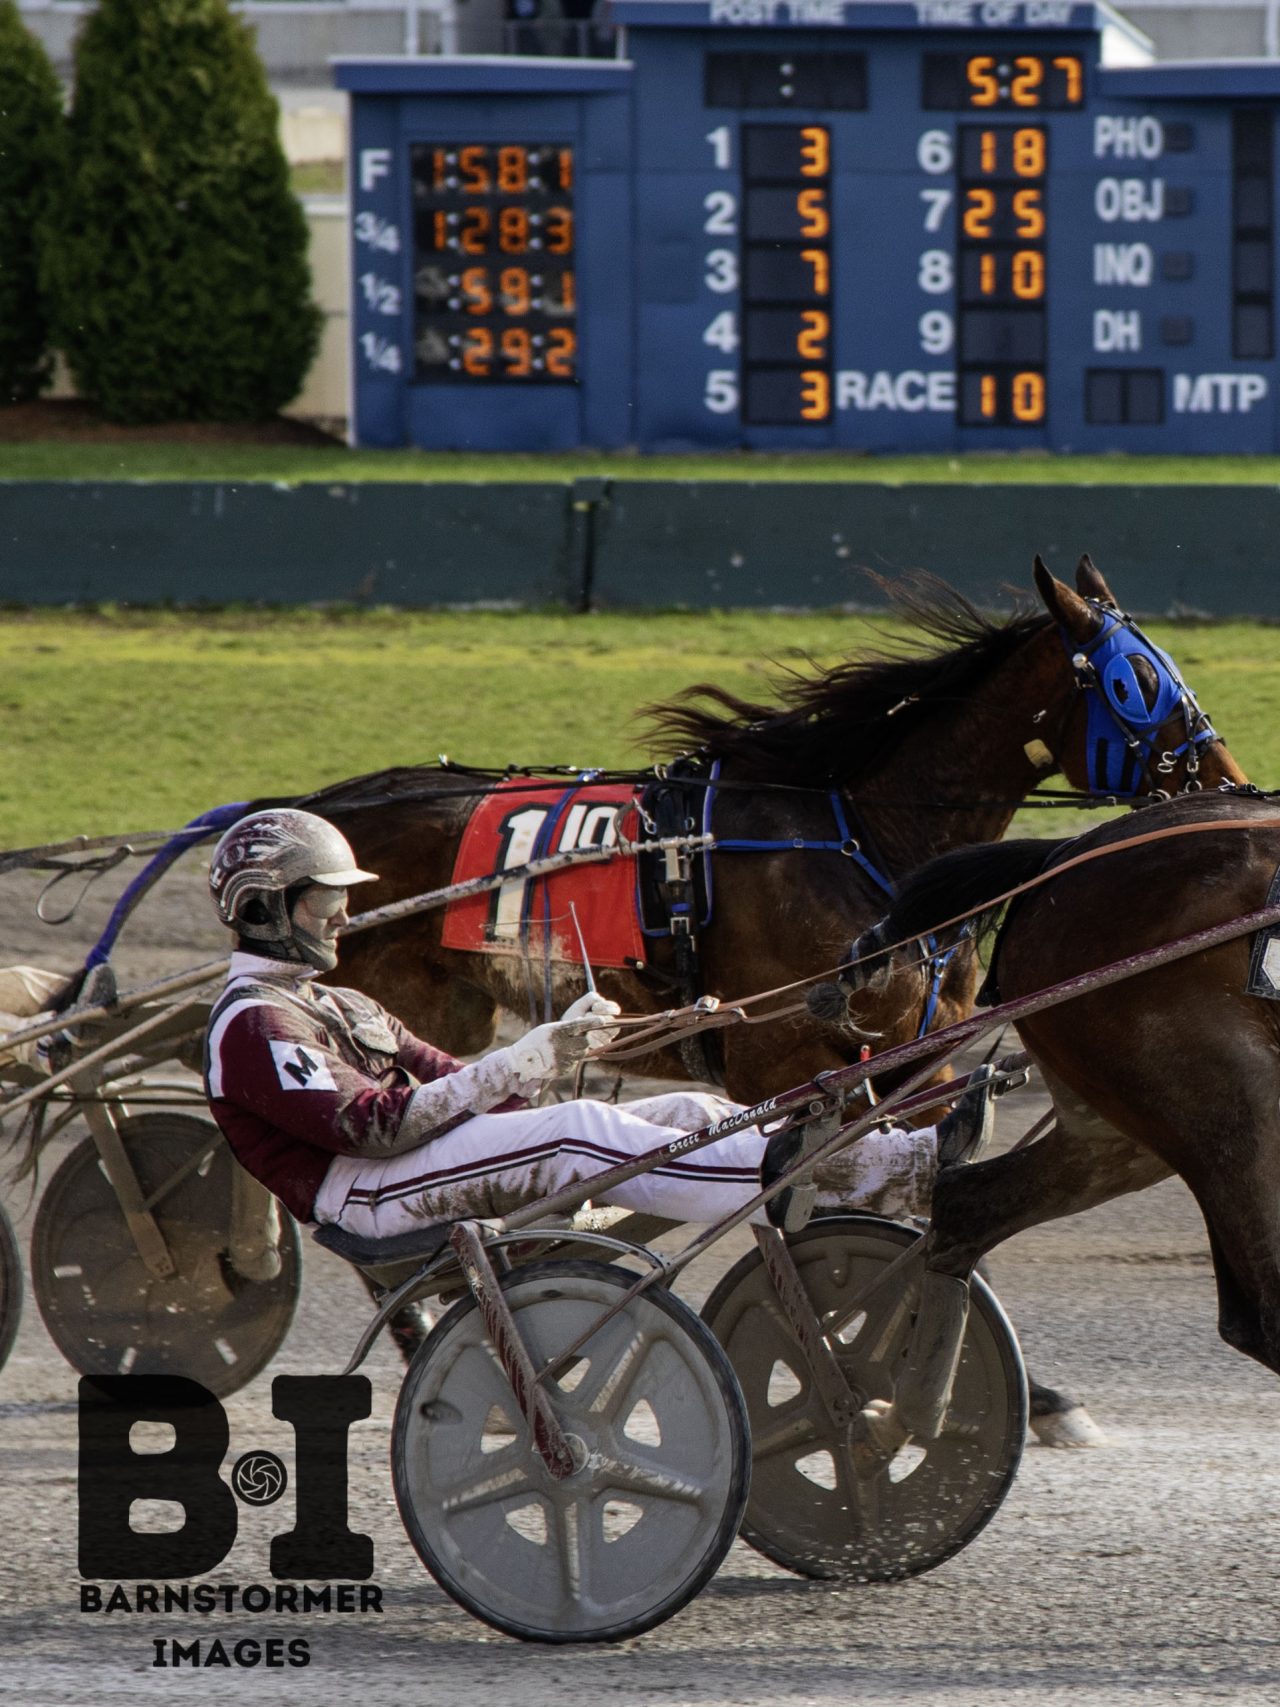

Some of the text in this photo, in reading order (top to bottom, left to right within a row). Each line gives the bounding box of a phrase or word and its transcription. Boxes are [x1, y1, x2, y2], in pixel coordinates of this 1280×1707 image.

[709, 0, 846, 25] POST TIME
[915, 0, 1073, 25] TIME OF DAY
[967, 56, 1082, 107] 5:27
[706, 127, 731, 169] 1
[799, 127, 831, 178] 3
[917, 130, 954, 175] 6
[980, 128, 1046, 178] 18
[1094, 117, 1163, 159] PHO
[360, 149, 392, 191] F
[705, 192, 737, 234] 2
[797, 189, 830, 238] 5
[920, 190, 953, 232] 7
[963, 188, 1046, 238] 25
[1095, 178, 1163, 221] OBJ
[705, 249, 737, 292] 3
[918, 250, 953, 294] 8
[980, 250, 1046, 299] 10
[1094, 243, 1152, 287] INQ
[704, 311, 738, 353] 4
[797, 311, 830, 360] 2
[920, 311, 954, 355] 9
[1093, 311, 1141, 352] DH
[705, 371, 738, 412] 5
[799, 371, 831, 420] 3
[836, 371, 957, 411] RACE
[980, 371, 1046, 421] 10
[1173, 373, 1268, 412] MTP
[490, 806, 550, 938] 1
[283, 1046, 318, 1087] M
[668, 1097, 777, 1153] Brett MacDonald
